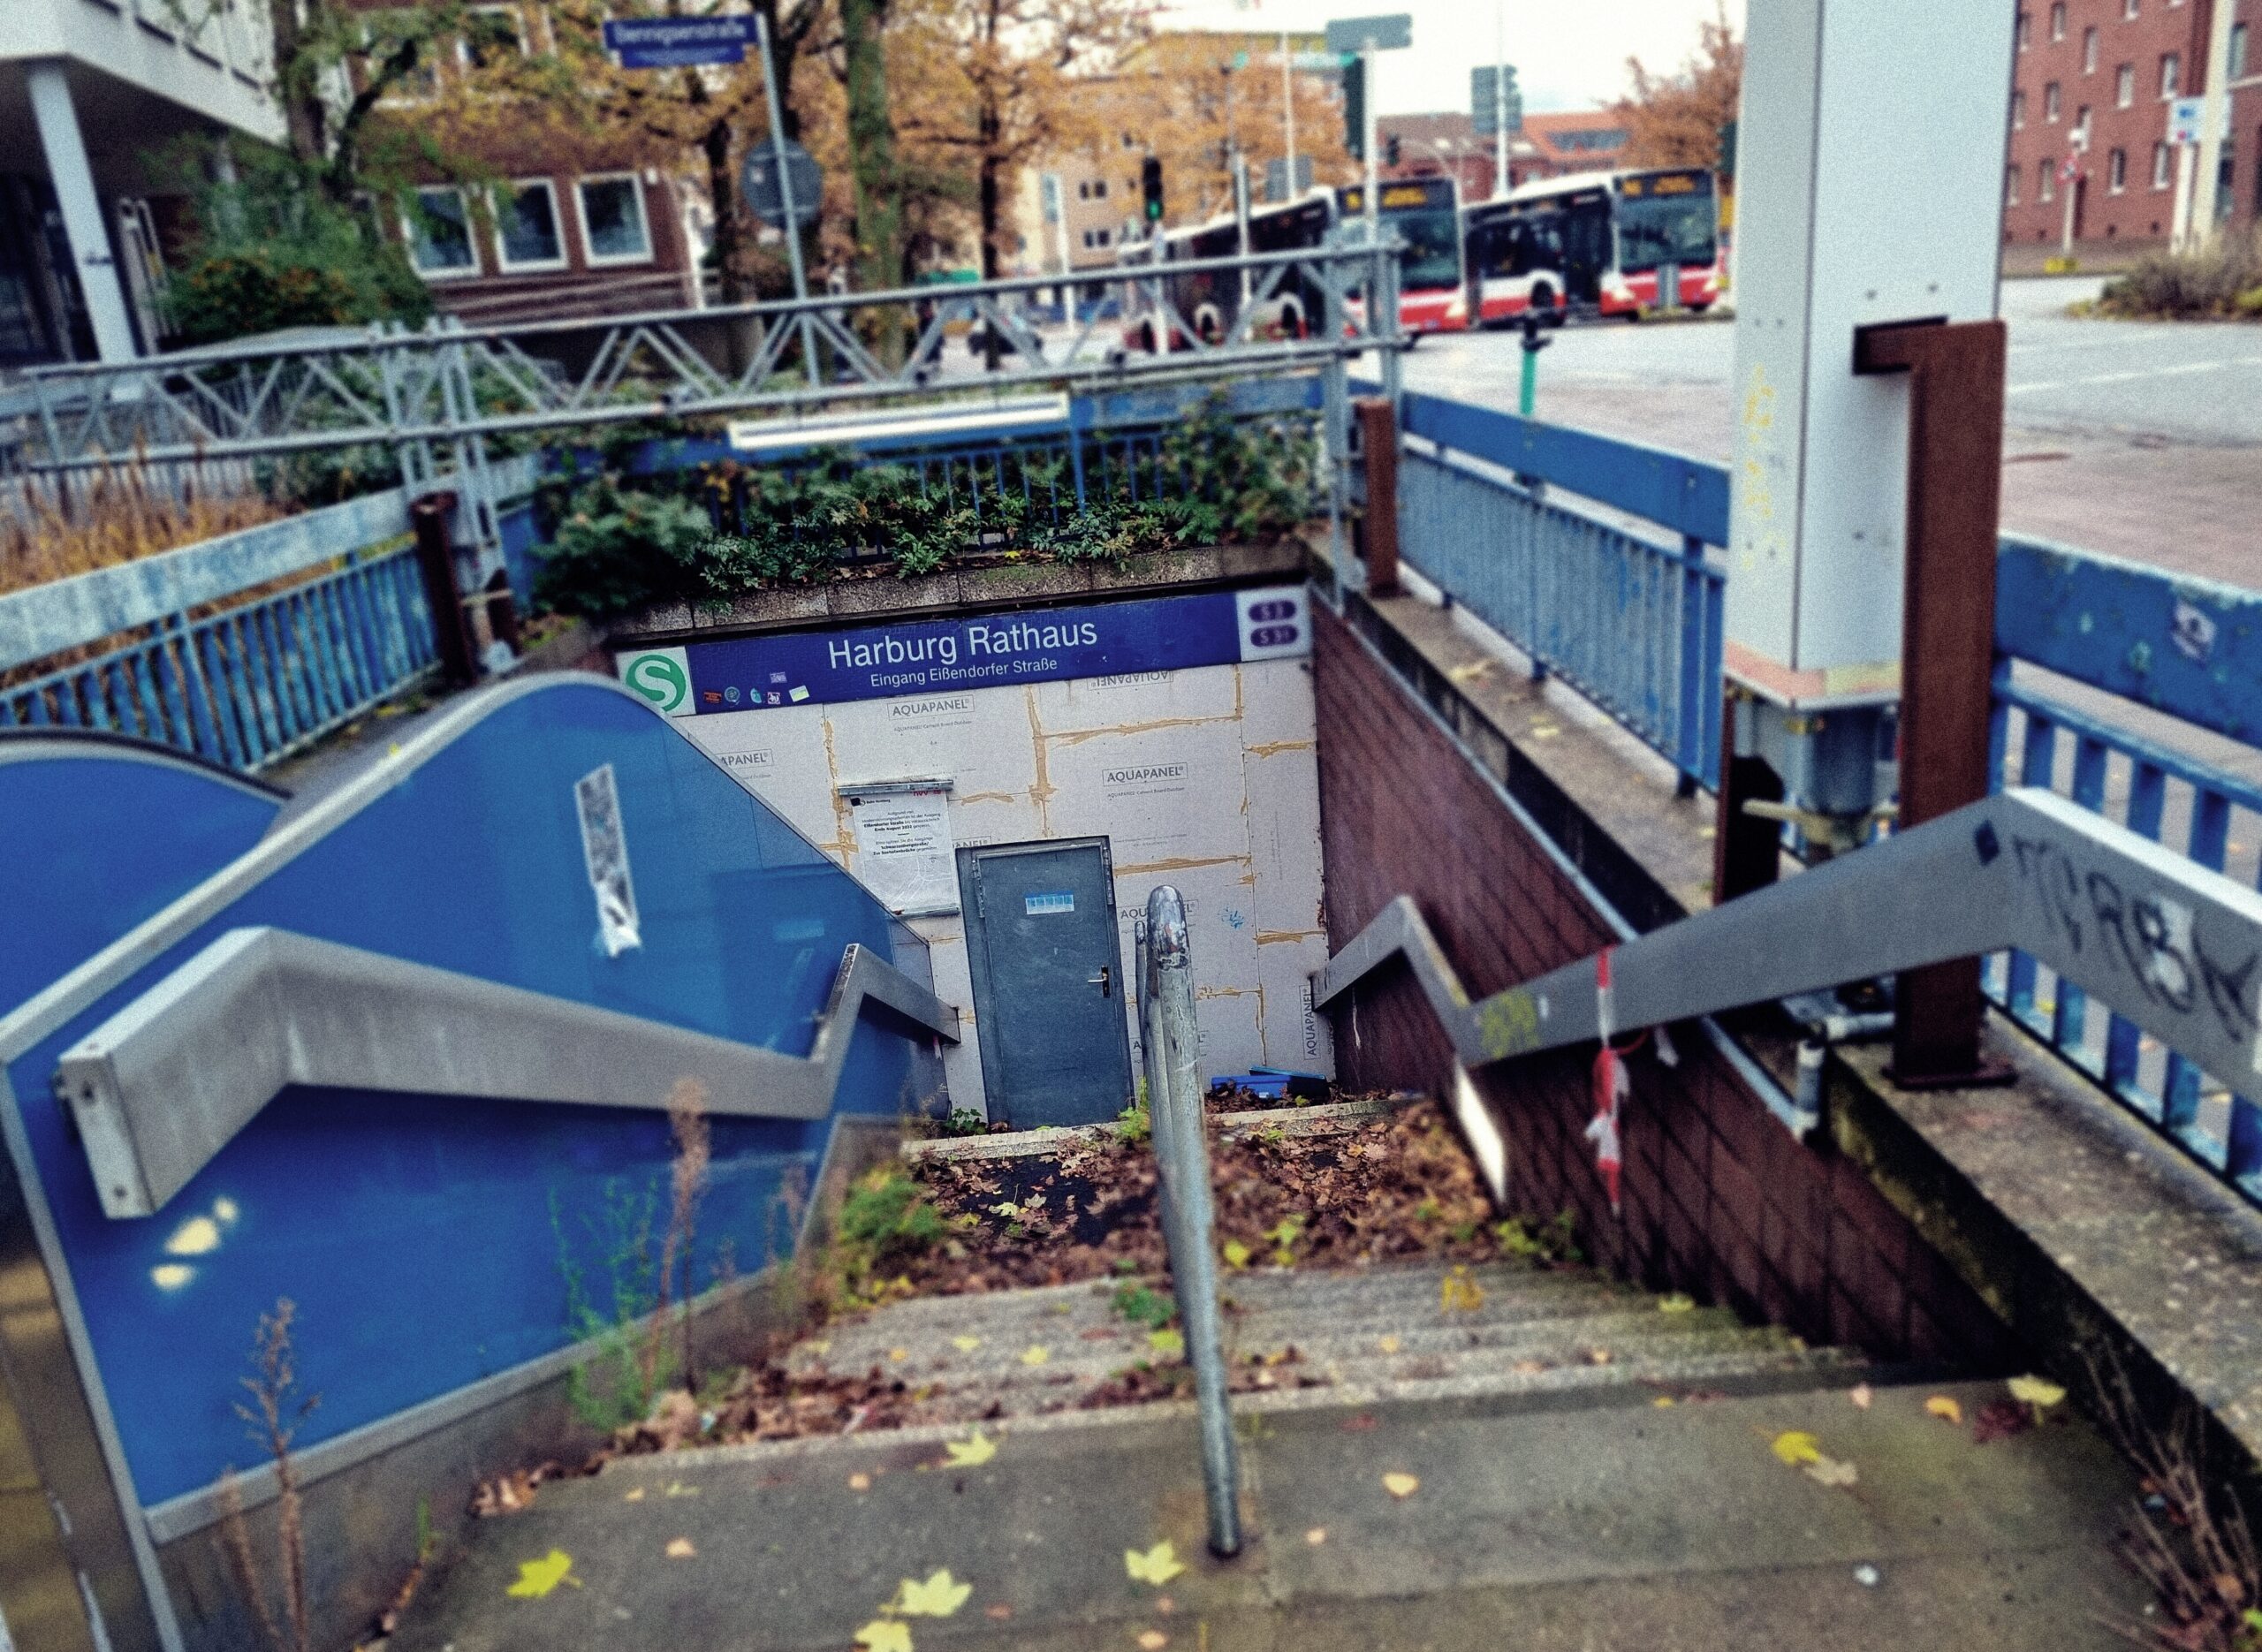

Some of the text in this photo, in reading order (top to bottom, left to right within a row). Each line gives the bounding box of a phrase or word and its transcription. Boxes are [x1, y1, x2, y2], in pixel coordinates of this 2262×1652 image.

[828, 622, 1097, 669] Harburg Rathaus
[632, 657, 679, 710] S
[870, 657, 1058, 688] Eingang Eißendorfer Straße
